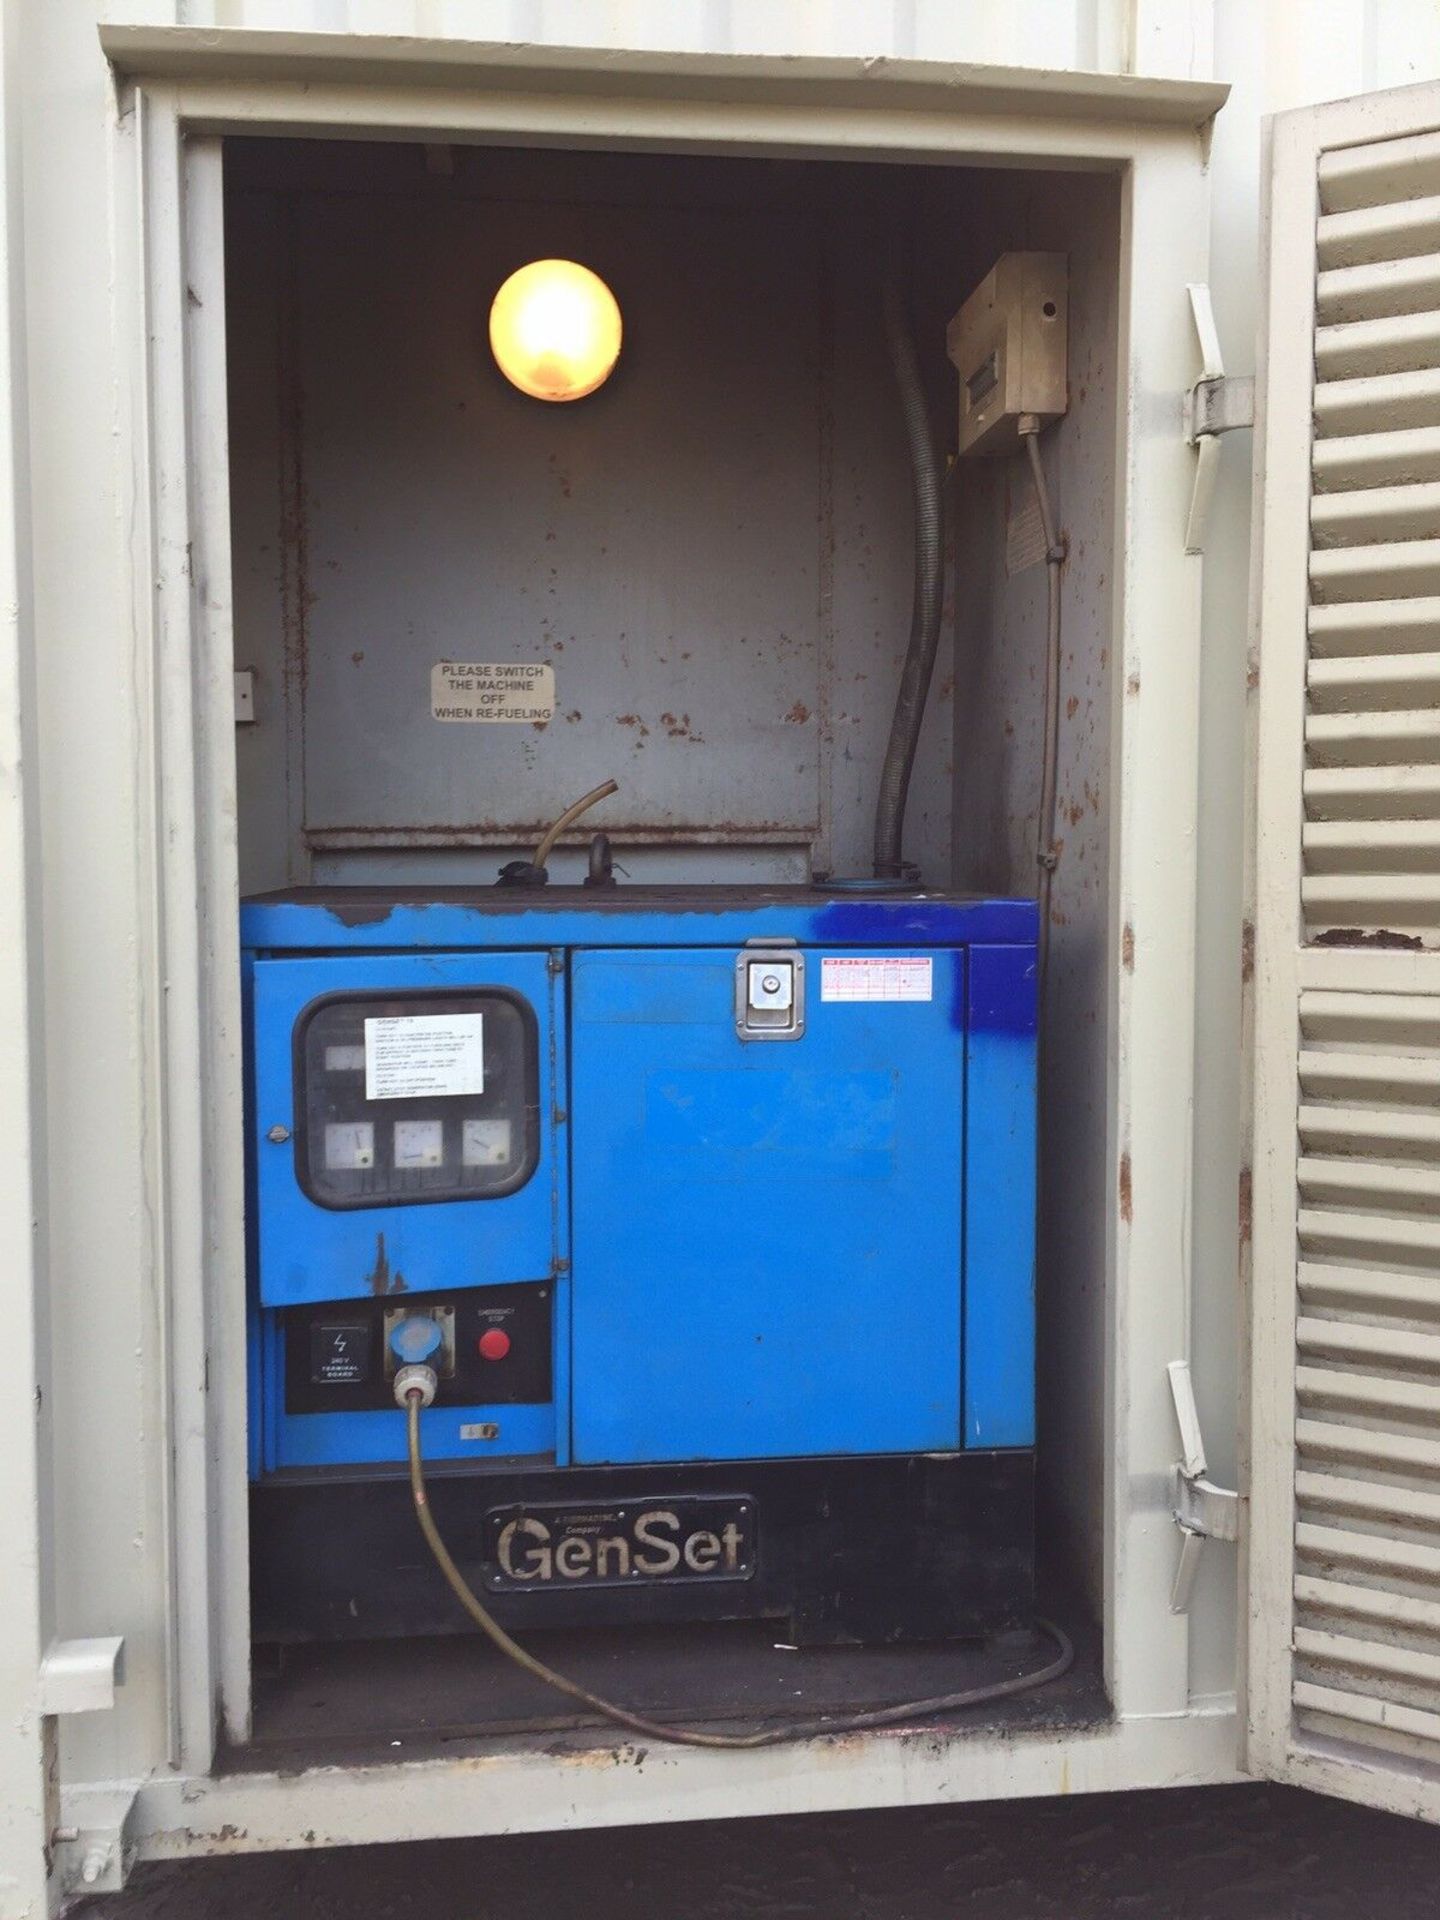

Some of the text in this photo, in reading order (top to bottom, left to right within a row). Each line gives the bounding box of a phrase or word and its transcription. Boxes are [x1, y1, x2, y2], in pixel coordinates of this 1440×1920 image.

[442, 666, 544, 677] PLEASE SWITCH
[448, 680, 534, 691] THE MACHINE
[480, 694, 506, 704] OFF
[435, 708, 551, 719] WHEN RE-FUELING
[497, 1511, 744, 1580] GenSet
